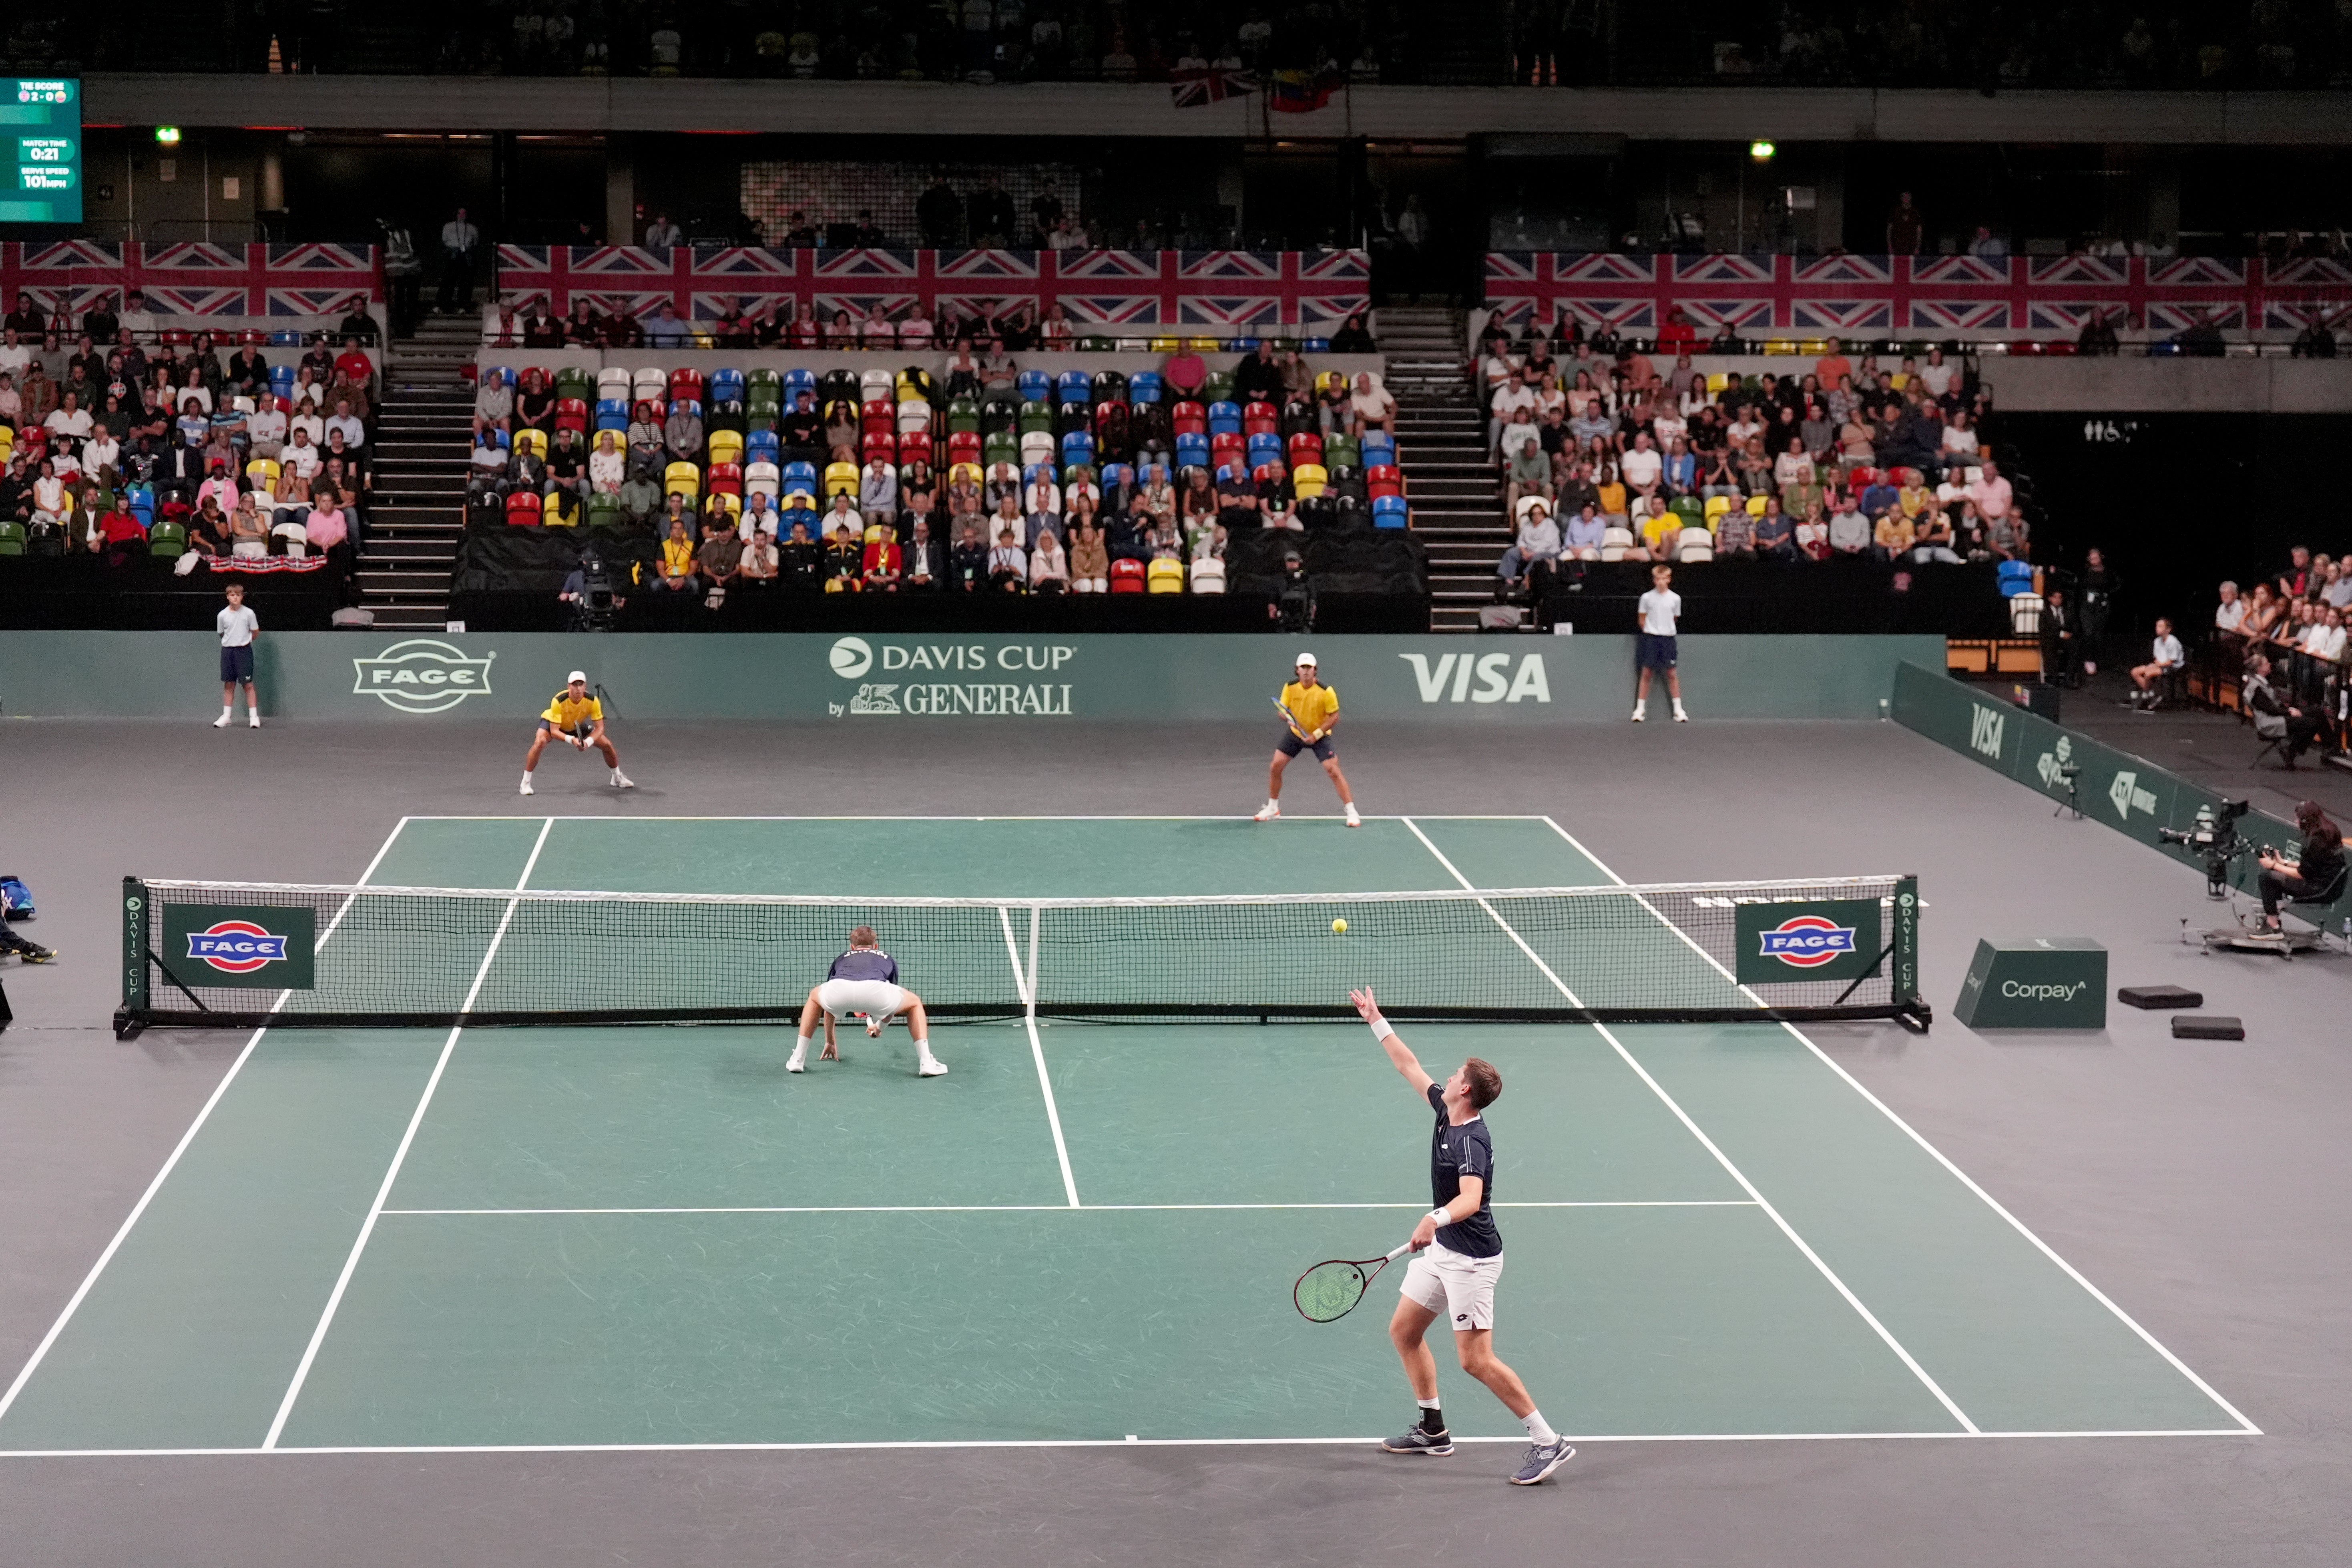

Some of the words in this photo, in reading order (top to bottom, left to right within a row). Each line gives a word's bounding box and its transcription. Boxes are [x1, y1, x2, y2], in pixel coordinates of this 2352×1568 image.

[20, 82, 33, 90] TIE
[34, 82, 64, 90] SCORE
[31, 92, 39, 101] 2
[45, 92, 54, 101] 0
[30, 148, 58, 160] 0:21
[883, 646, 987, 670] DAVIS
[997, 646, 1073, 671] CUP
[372, 669, 475, 684] FAGE
[1398, 652, 1551, 704] VISA
[829, 702, 844, 717] by
[904, 684, 1073, 715] GENERALI
[1971, 703, 2004, 759] VISA
[129, 912, 139, 958] DAVIS
[1772, 935, 1845, 948] FAGE
[1902, 908, 1912, 954] DAVIS
[200, 941, 276, 954] FAGE
[129, 968, 139, 996] CUP
[1902, 963, 1912, 990] CUP
